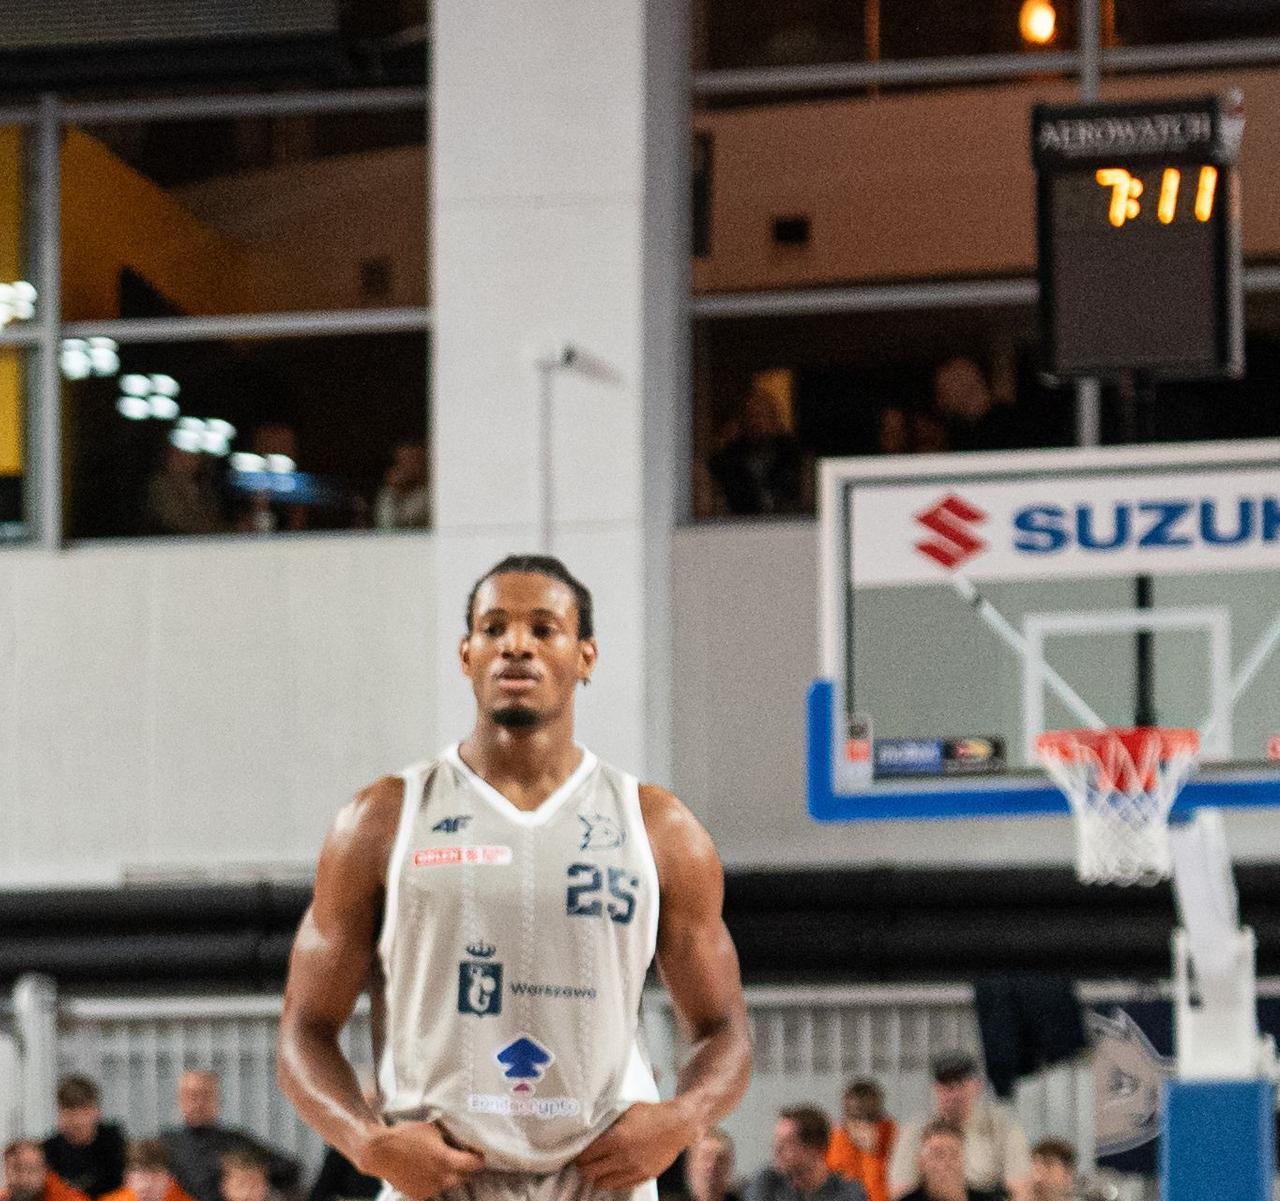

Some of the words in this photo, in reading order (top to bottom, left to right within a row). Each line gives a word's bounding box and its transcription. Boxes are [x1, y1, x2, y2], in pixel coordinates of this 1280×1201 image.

[1096, 166, 1218, 228] 7:11
[567, 863, 639, 925] 25
[510, 982, 597, 1000] Warszawa
